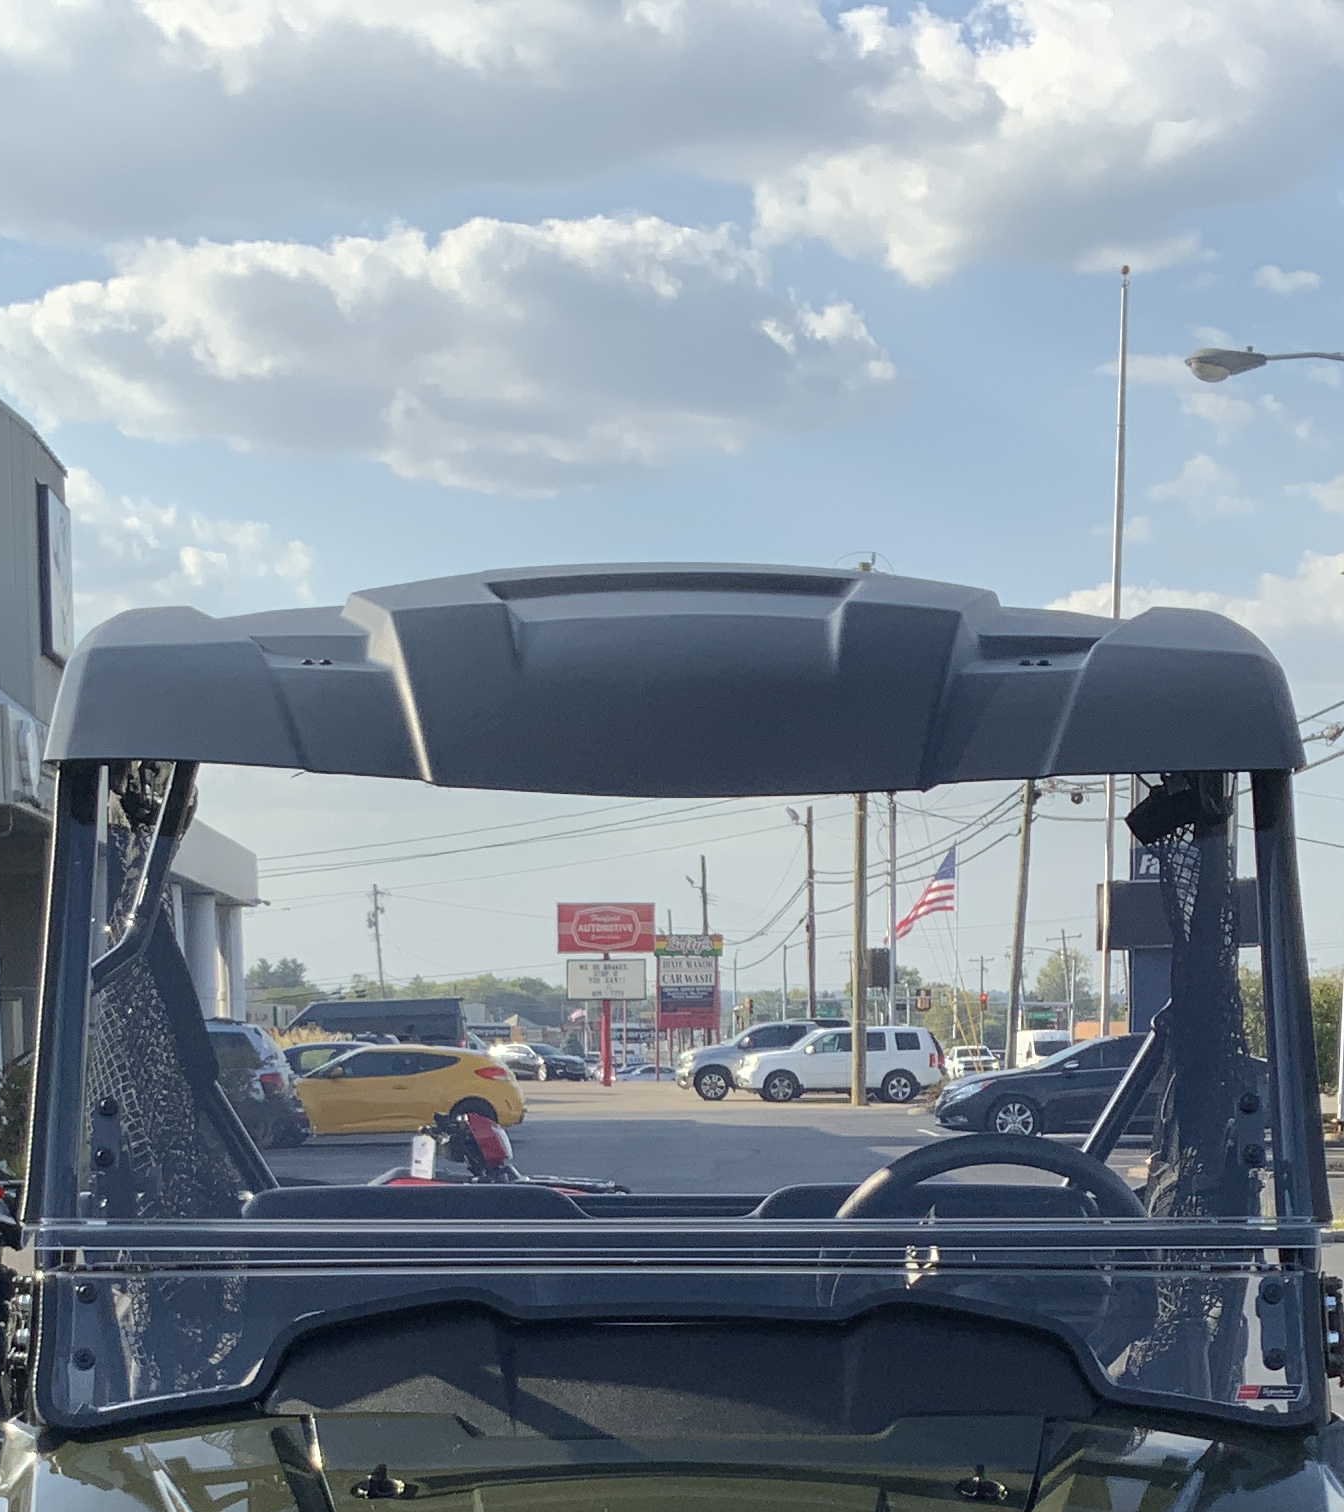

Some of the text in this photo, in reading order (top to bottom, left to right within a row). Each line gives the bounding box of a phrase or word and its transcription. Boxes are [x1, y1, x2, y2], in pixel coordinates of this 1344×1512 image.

[578, 923, 633, 933] AUTOMOTIVE
[662, 961, 713, 969] DIXIE MANOR
[662, 973, 713, 984] CAR WASH
